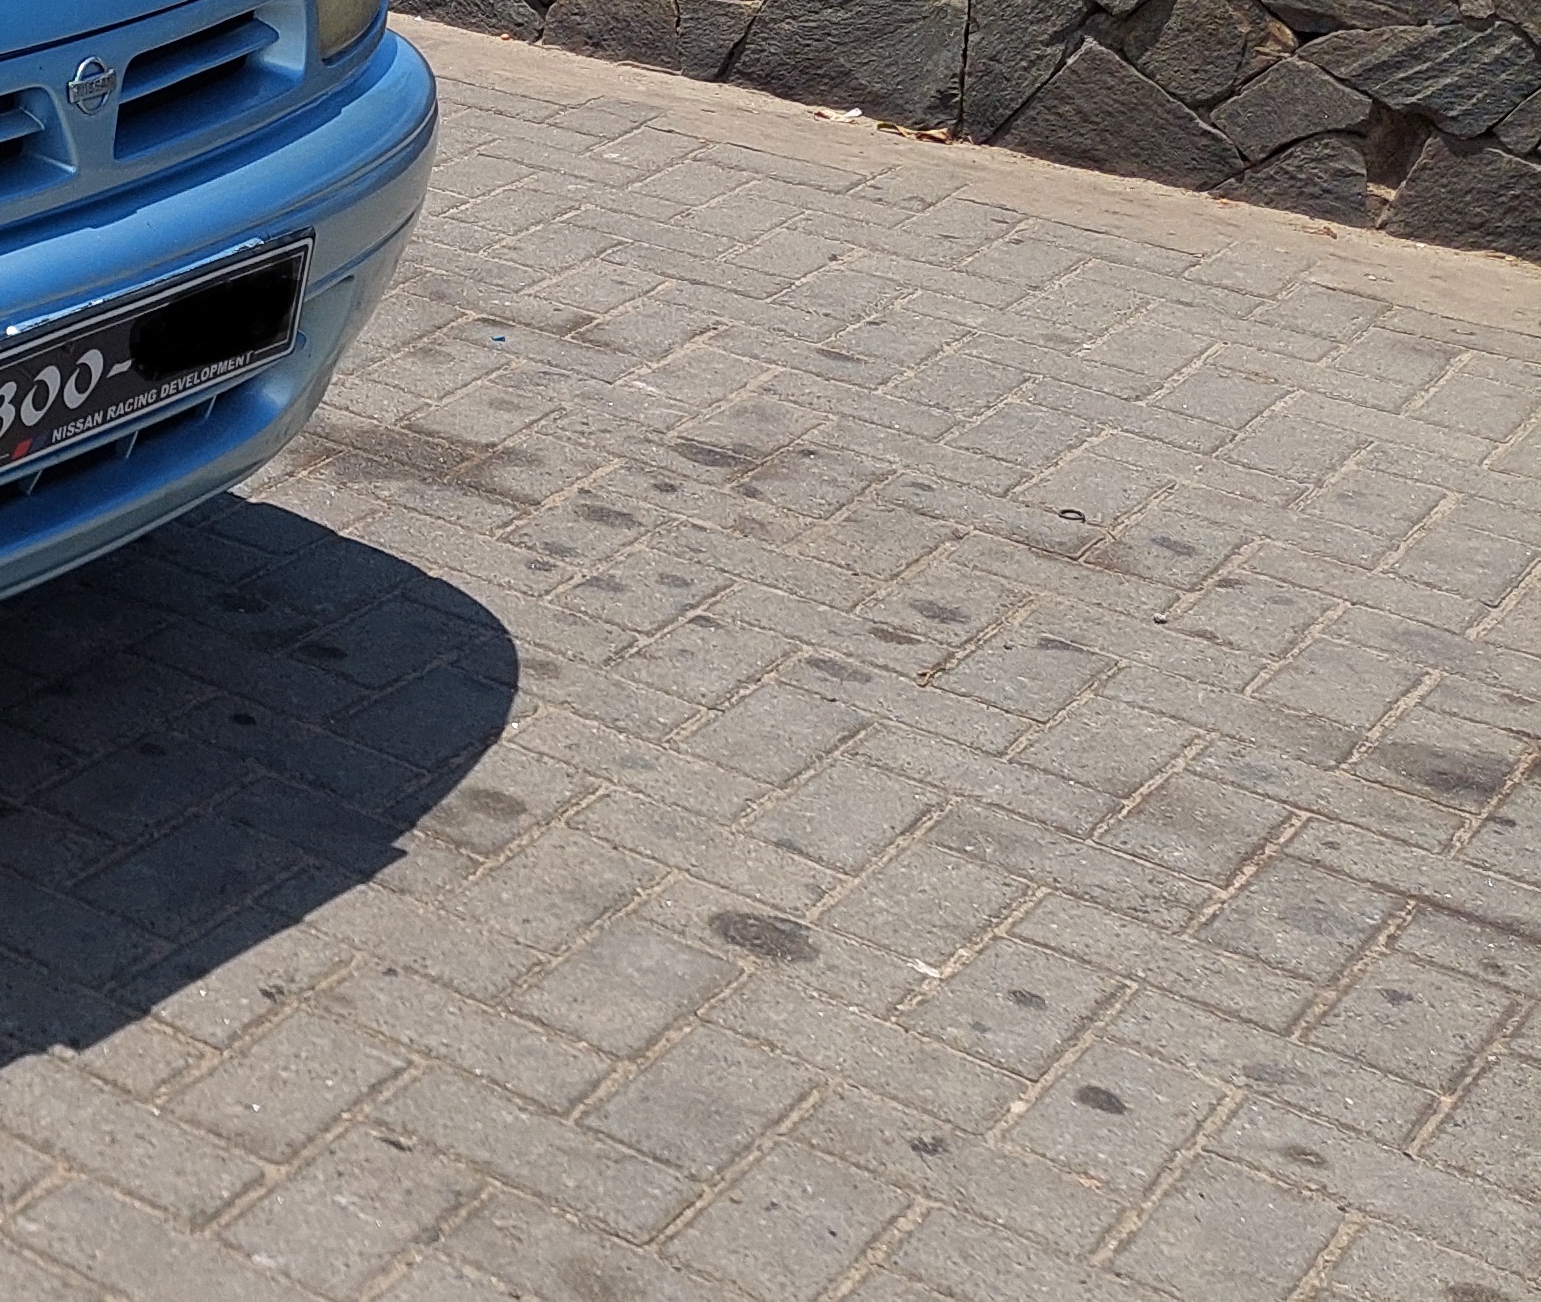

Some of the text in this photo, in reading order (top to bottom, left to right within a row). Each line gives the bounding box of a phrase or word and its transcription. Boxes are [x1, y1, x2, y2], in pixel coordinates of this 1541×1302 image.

[51, 350, 255, 444] NISSAN RACING DEVELOPMENT
